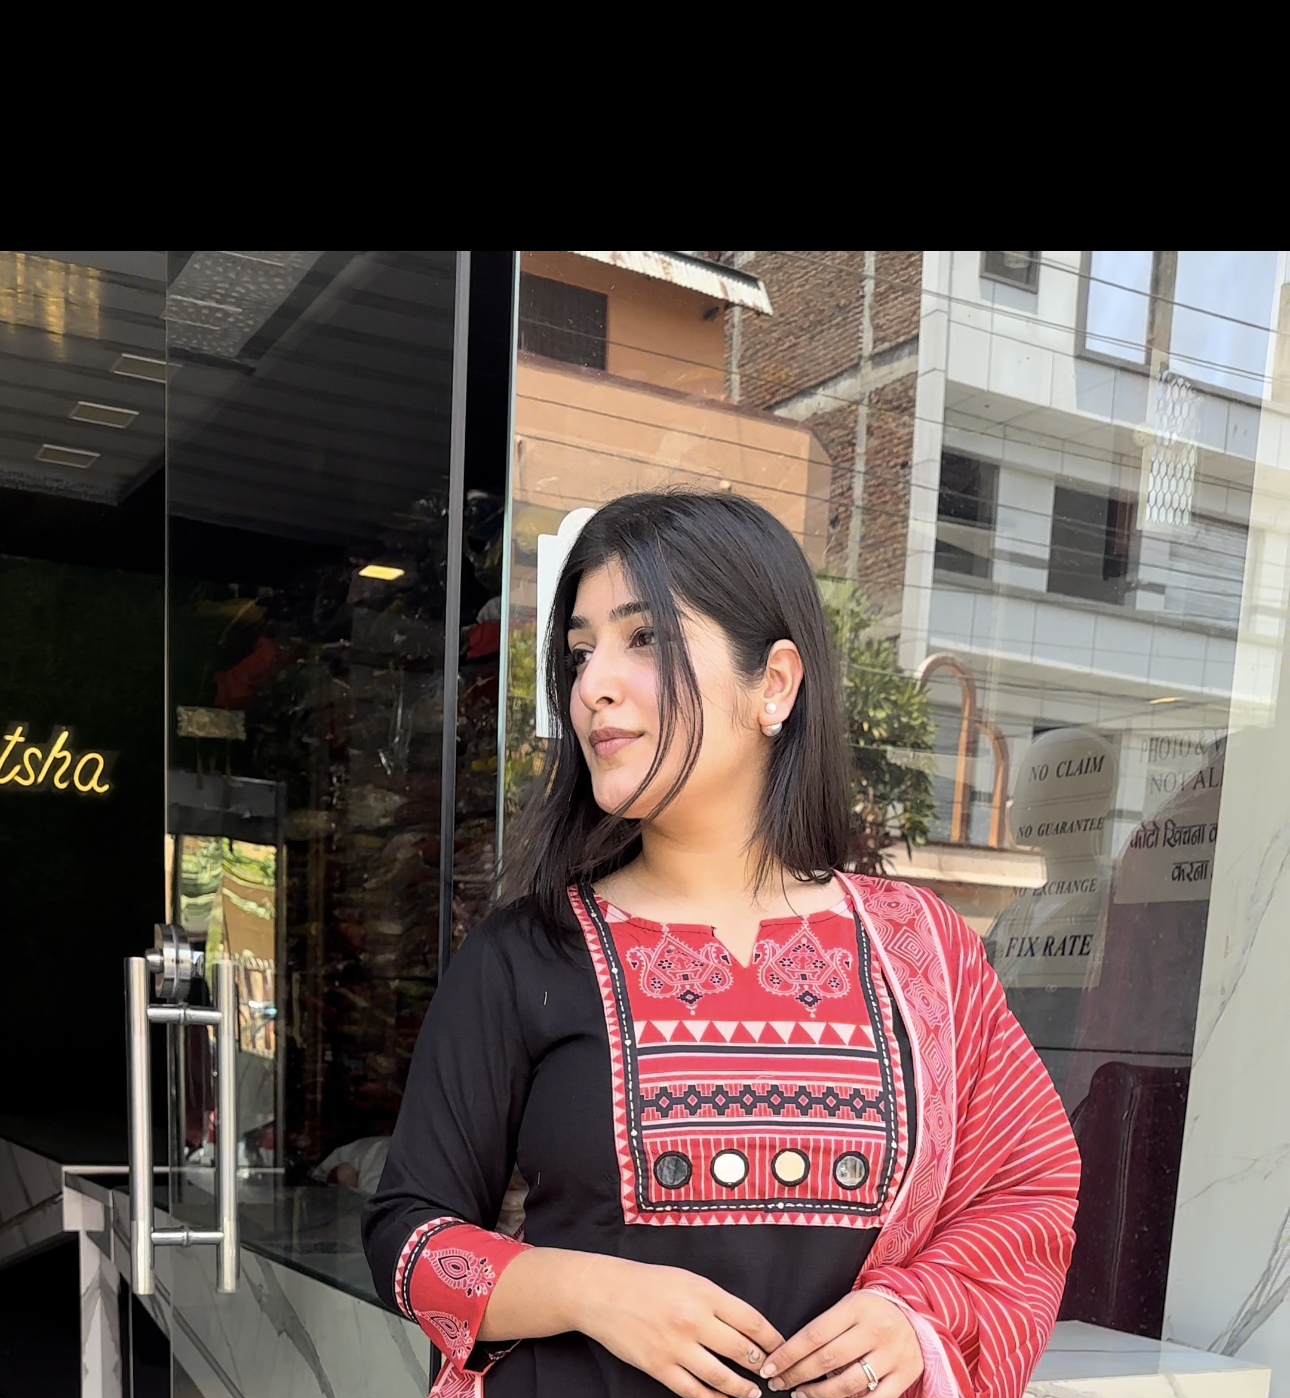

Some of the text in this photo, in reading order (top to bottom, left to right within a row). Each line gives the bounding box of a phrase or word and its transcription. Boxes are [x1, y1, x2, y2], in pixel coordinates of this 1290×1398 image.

[1139, 735, 1192, 764] PHOTO
[1028, 755, 1105, 783] NO CLAIM
[1150, 766, 1222, 795] NOT AL
[1016, 816, 1105, 840] NO GUARANTEE
[1171, 859, 1210, 883] करना
[1005, 934, 1093, 958] FIX RATE
